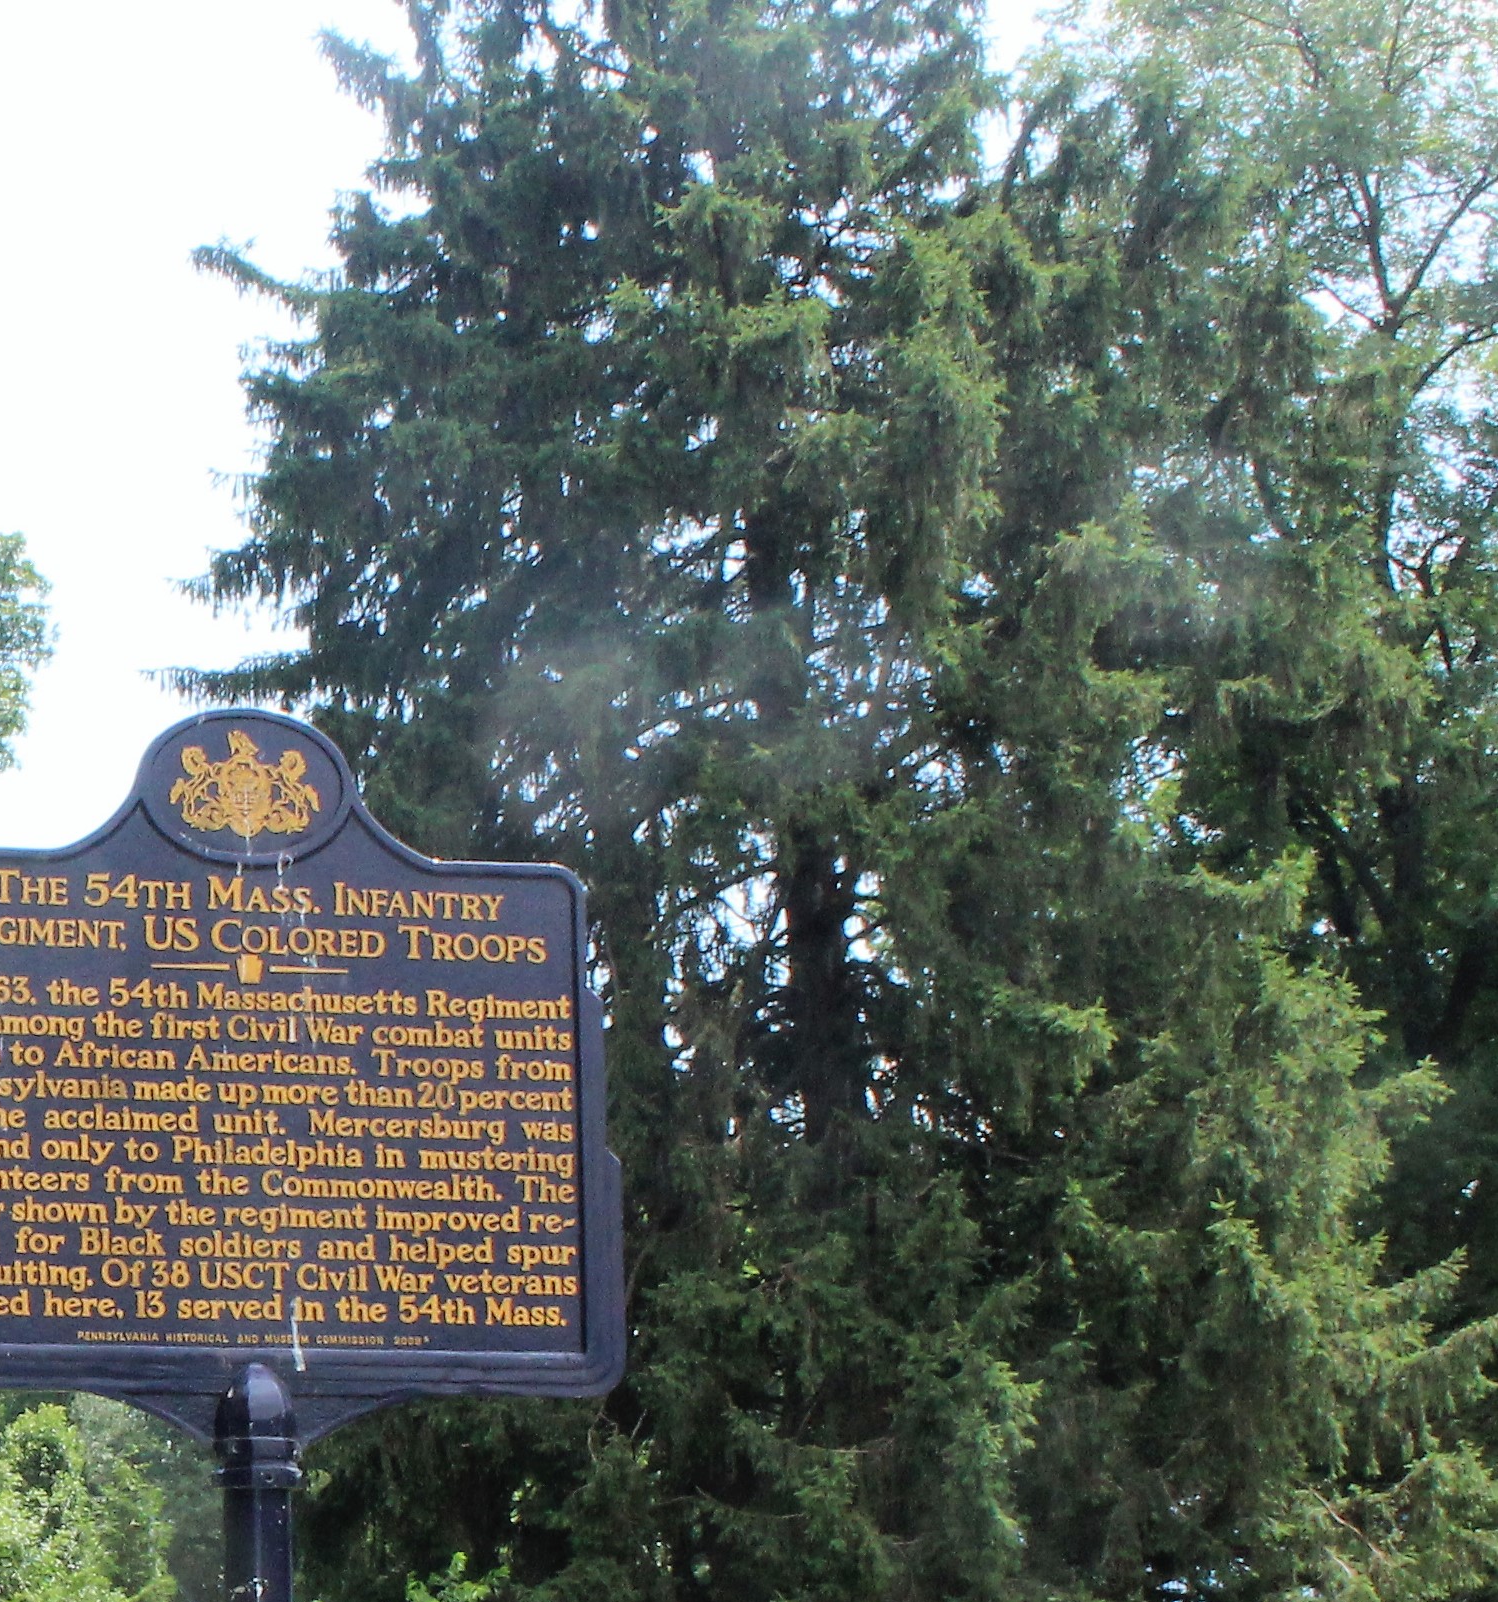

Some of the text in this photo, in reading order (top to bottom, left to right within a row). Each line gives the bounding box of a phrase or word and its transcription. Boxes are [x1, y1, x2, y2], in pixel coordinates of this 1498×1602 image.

[84, 873, 192, 910] 54TH
[207, 876, 321, 914] MASS.
[333, 881, 504, 921] INFANTRY
[143, 915, 200, 951] US
[211, 918, 387, 958] COLORED
[398, 924, 547, 964] TROOPS
[46, 978, 100, 1006] the
[109, 977, 188, 1009] 54th
[197, 982, 418, 1016] Massachusetts
[426, 990, 571, 1023] Regiment
[92, 1011, 142, 1038] the
[150, 1012, 220, 1040] first
[227, 1015, 298, 1043] Civil
[305, 1017, 364, 1045] War
[371, 1021, 484, 1048] combat
[495, 1026, 572, 1051] units
[9, 1041, 45, 1067] to
[54, 1041, 176, 1070] African
[185, 1045, 357, 1075] Americans.
[371, 1049, 484, 1084] Troops
[495, 1054, 571, 1081] from
[134, 1076, 212, 1102] made
[217, 1083, 261, 1109] up
[261, 1082, 339, 1106] more
[344, 1079, 416, 1108] than
[417, 1081, 453, 1109] 20
[459, 1086, 572, 1116] percent
[43, 1103, 199, 1132] acclaimed
[213, 1109, 287, 1136] unit.
[308, 1109, 506, 1145] Mercersburg
[521, 1120, 574, 1142] was
[41, 1134, 115, 1165] only
[124, 1137, 160, 1163] to
[172, 1135, 363, 1172] Philadelphia
[375, 1143, 405, 1169] in
[419, 1147, 574, 1179] mustering
[104, 1166, 183, 1194] from
[196, 1168, 249, 1195] the
[261, 1169, 503, 1201] Commonwealth.
[515, 1175, 575, 1204] The
[11, 1196, 108, 1224] shown
[114, 1198, 157, 1228] by
[165, 1199, 216, 1226] the
[223, 1204, 366, 1233] regiment
[375, 1205, 521, 1237] improved
[528, 1213, 576, 1234] re-
[14, 1226, 65, 1254] for
[79, 1227, 166, 1256] Black
[180, 1230, 302, 1259] soldiers
[317, 1234, 376, 1261] and
[389, 1234, 494, 1270] helped
[507, 1245, 577, 1271] spur
[101, 1258, 145, 1287] Of
[152, 1260, 191, 1288] 38
[199, 1262, 290, 1290] USCT
[296, 1263, 368, 1292] Civil
[374, 1265, 435, 1293] War
[444, 1269, 577, 1296] veterans
[43, 1289, 124, 1320] here,
[136, 1291, 167, 1319] 13
[177, 1294, 283, 1322] served
[294, 1297, 324, 1322] in
[335, 1296, 387, 1323] the
[399, 1294, 476, 1324] 54th
[485, 1297, 567, 1326] Mass.
[77, 1331, 159, 1342] PENNSYLVANIA
[166, 1333, 229, 1343] HISTORICAL
[236, 1334, 260, 1344] AND
[315, 1334, 384, 1345] COMMISSION
